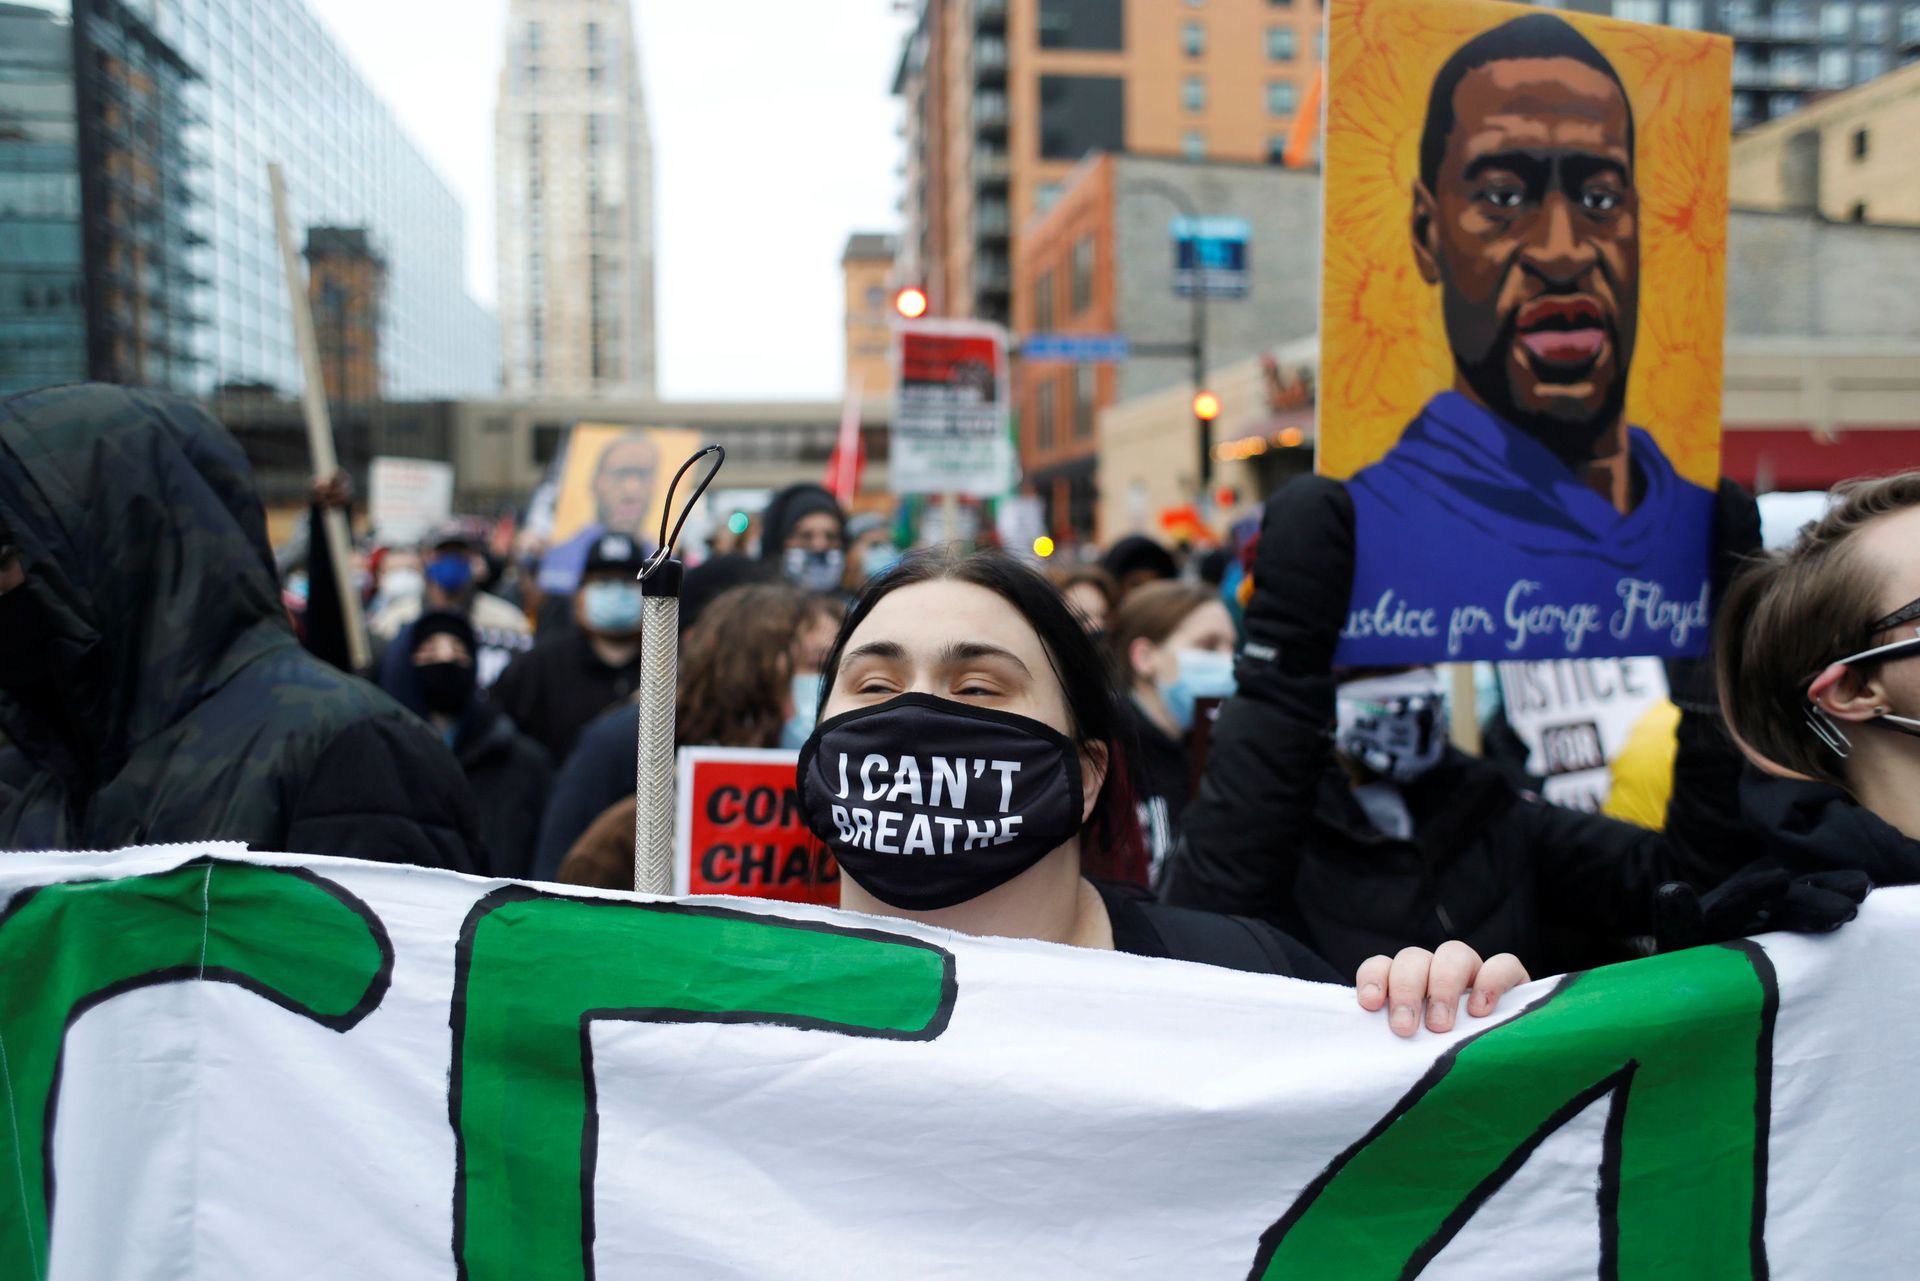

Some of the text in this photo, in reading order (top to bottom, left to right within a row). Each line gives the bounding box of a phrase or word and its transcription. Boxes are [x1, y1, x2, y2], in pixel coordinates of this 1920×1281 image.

[1340, 577, 1711, 656] ustice for George Floyd
[706, 785, 808, 826] CON
[834, 753, 1022, 813] I CAN'T
[831, 805, 1023, 856] BREATHE
[700, 845, 840, 885] CHAU
